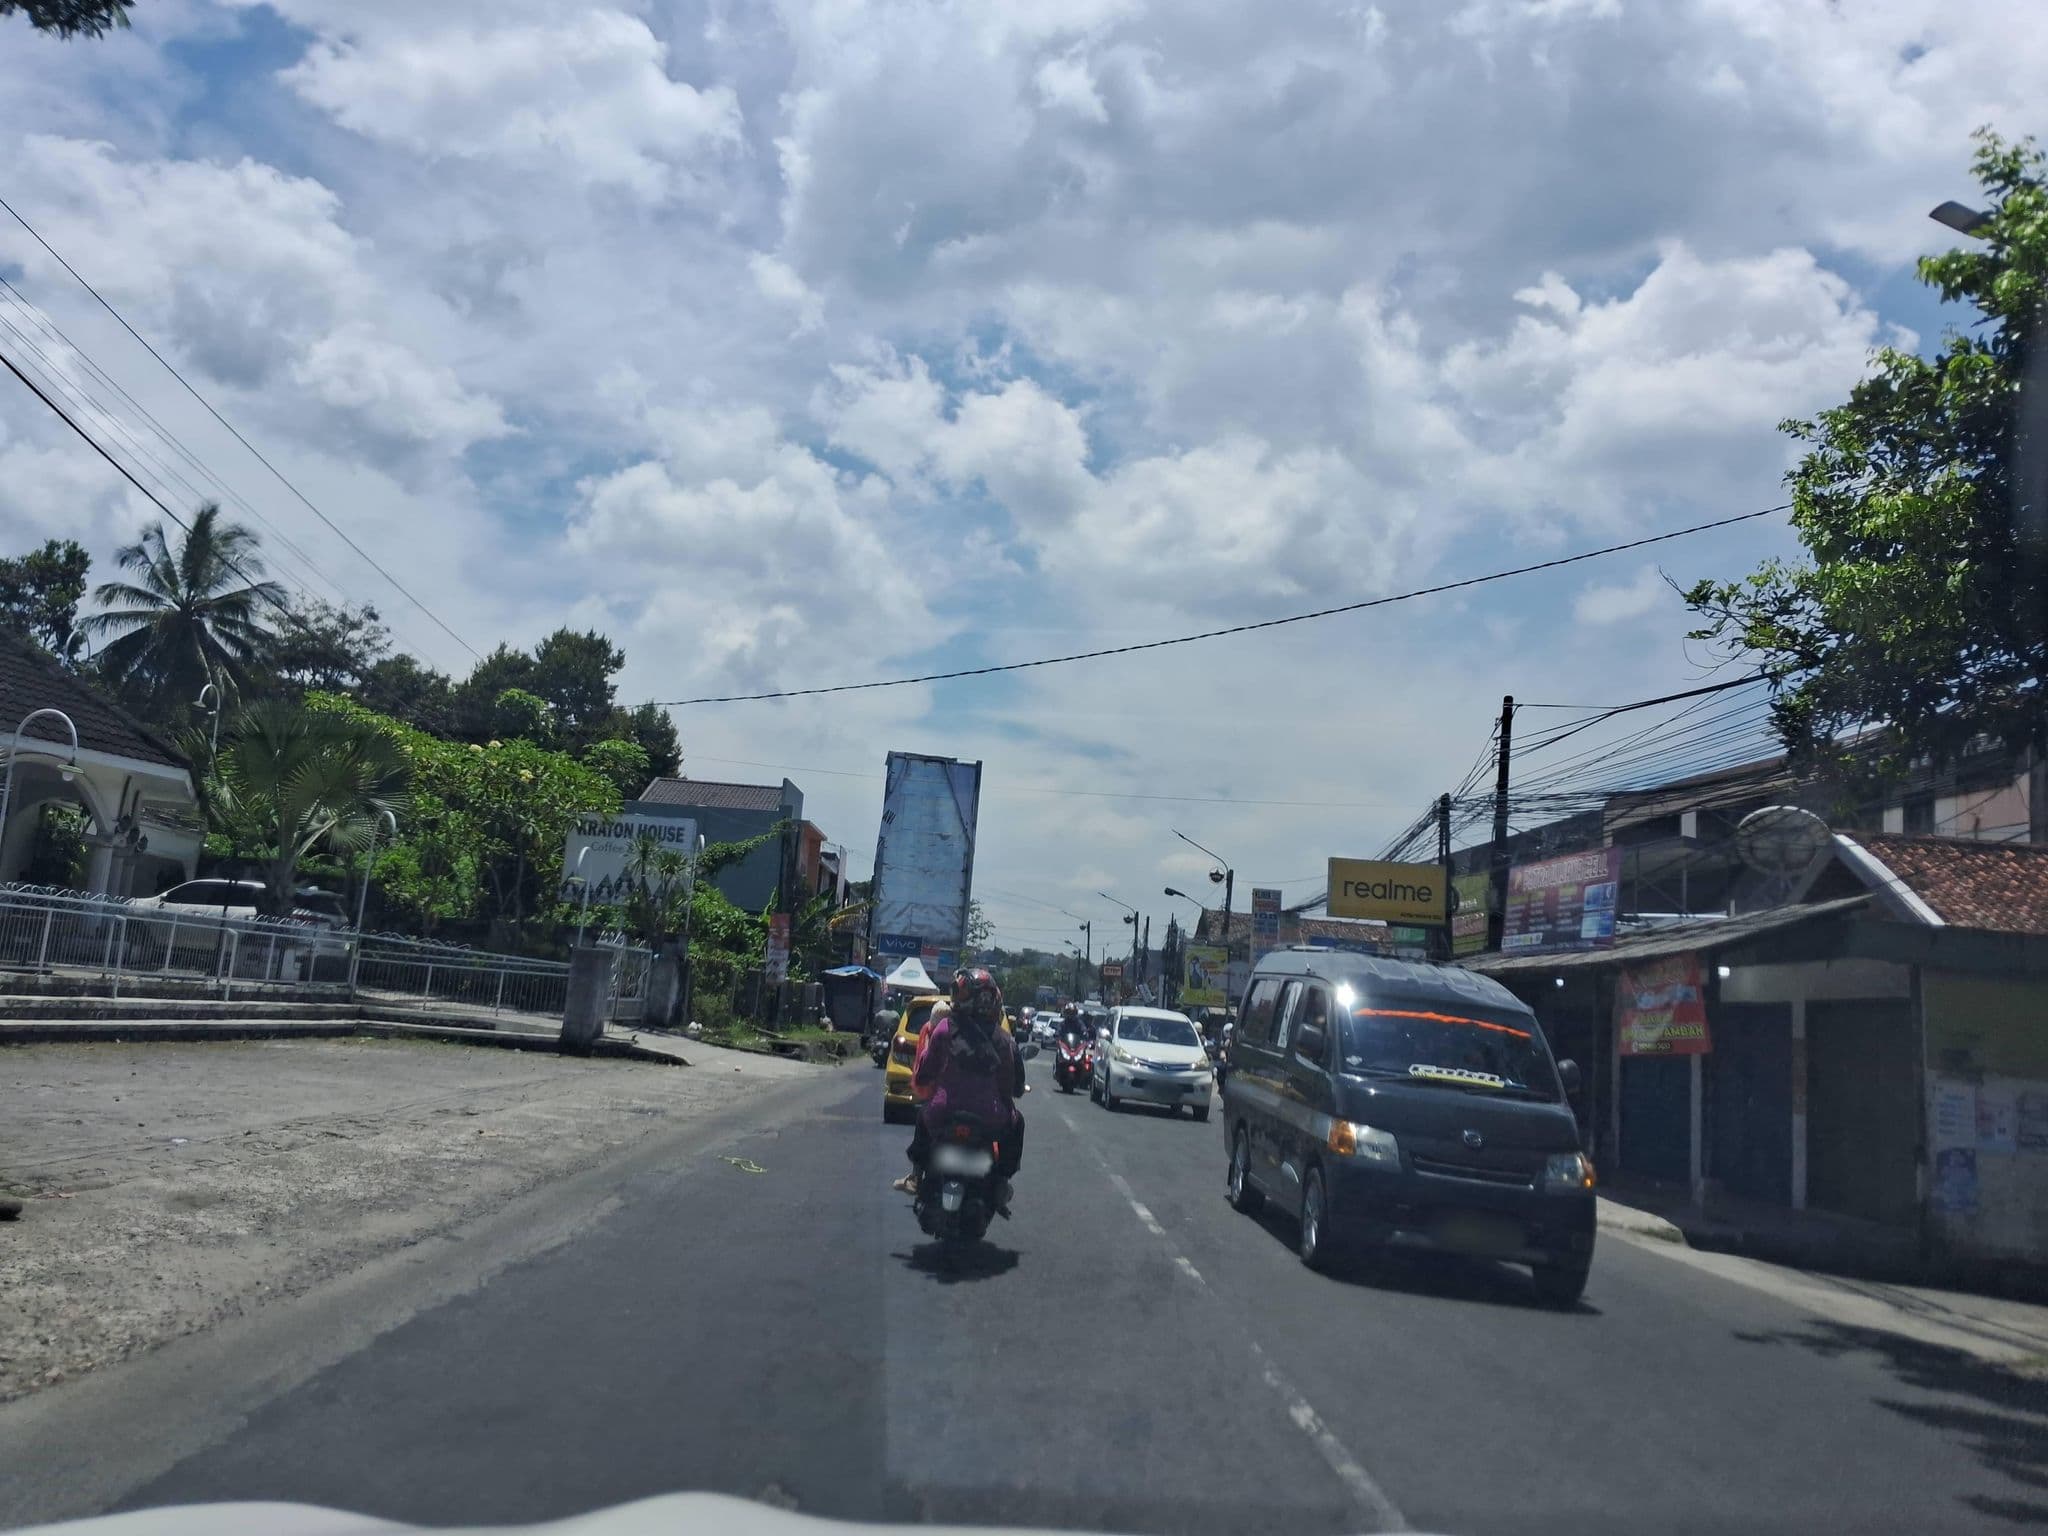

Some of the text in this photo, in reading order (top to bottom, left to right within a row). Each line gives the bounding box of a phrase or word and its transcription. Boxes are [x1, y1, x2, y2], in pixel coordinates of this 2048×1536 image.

[576, 819, 685, 843] KRATON HOUSE
[1343, 879, 1433, 902] realme
